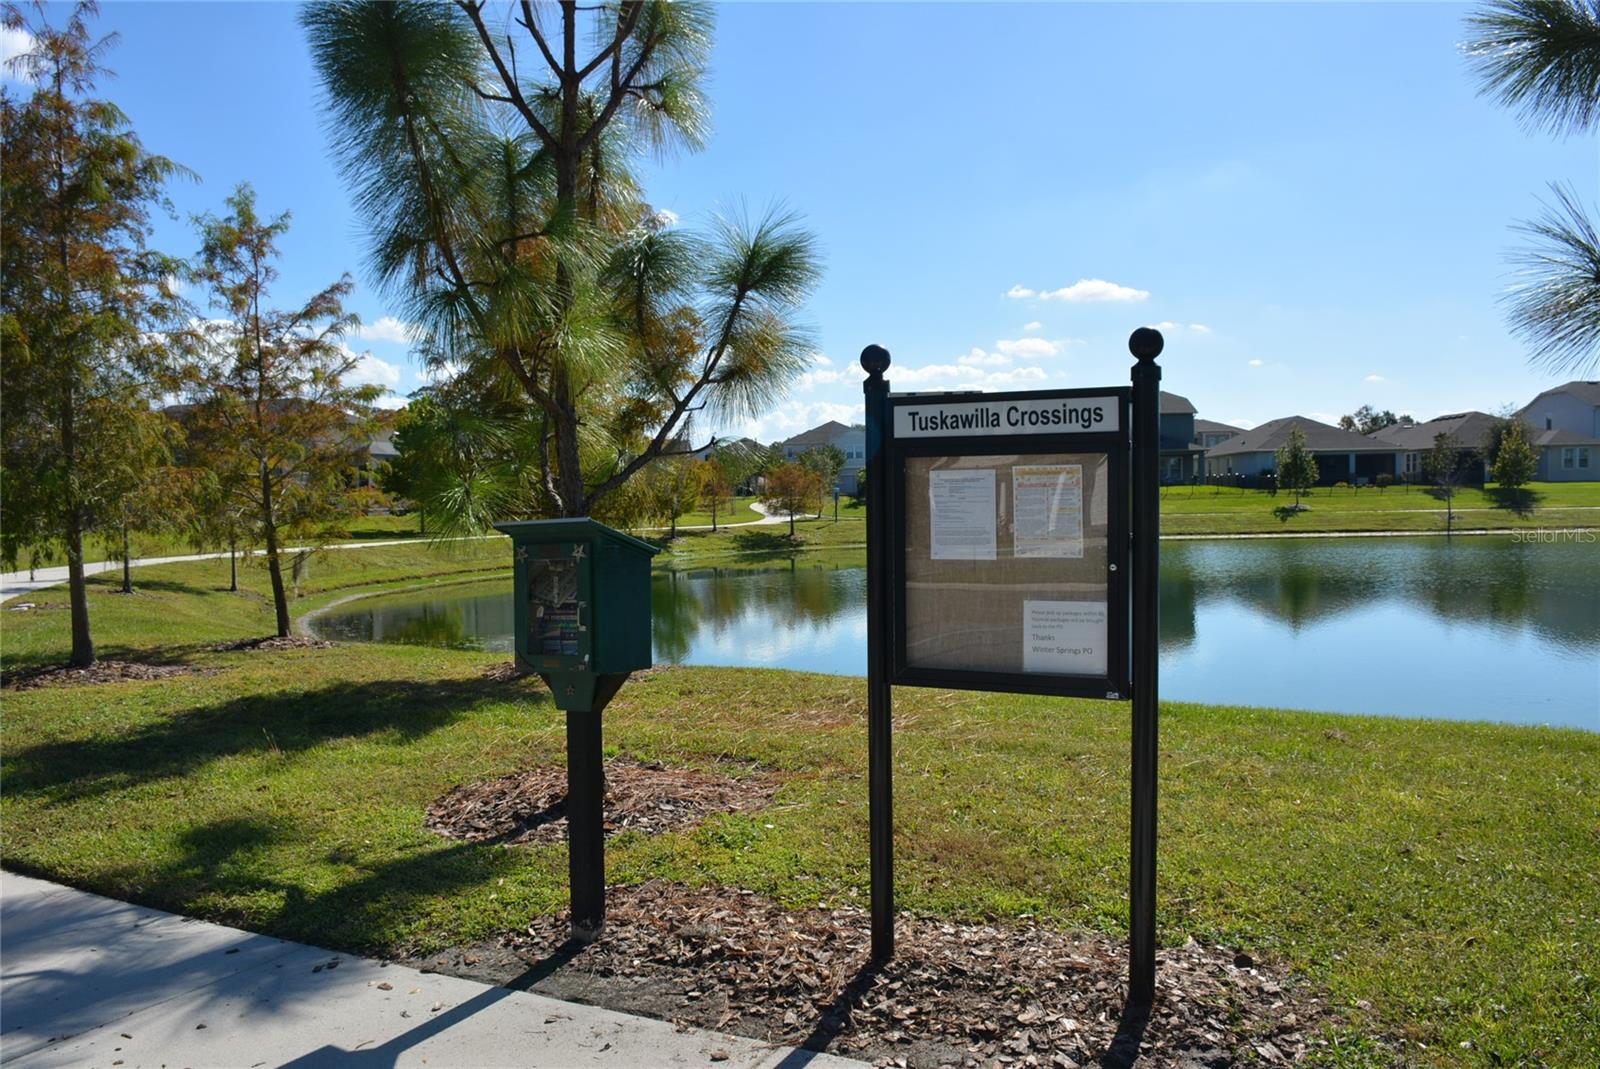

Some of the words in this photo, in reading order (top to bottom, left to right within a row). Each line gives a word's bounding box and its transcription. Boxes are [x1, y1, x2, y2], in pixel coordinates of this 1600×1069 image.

[908, 407, 1000, 431] Tuskawilla
[1006, 404, 1103, 428] Crossings
[1032, 633, 1055, 641] Thanks
[1056, 646, 1081, 656] Springs
[1083, 647, 1093, 655] PO
